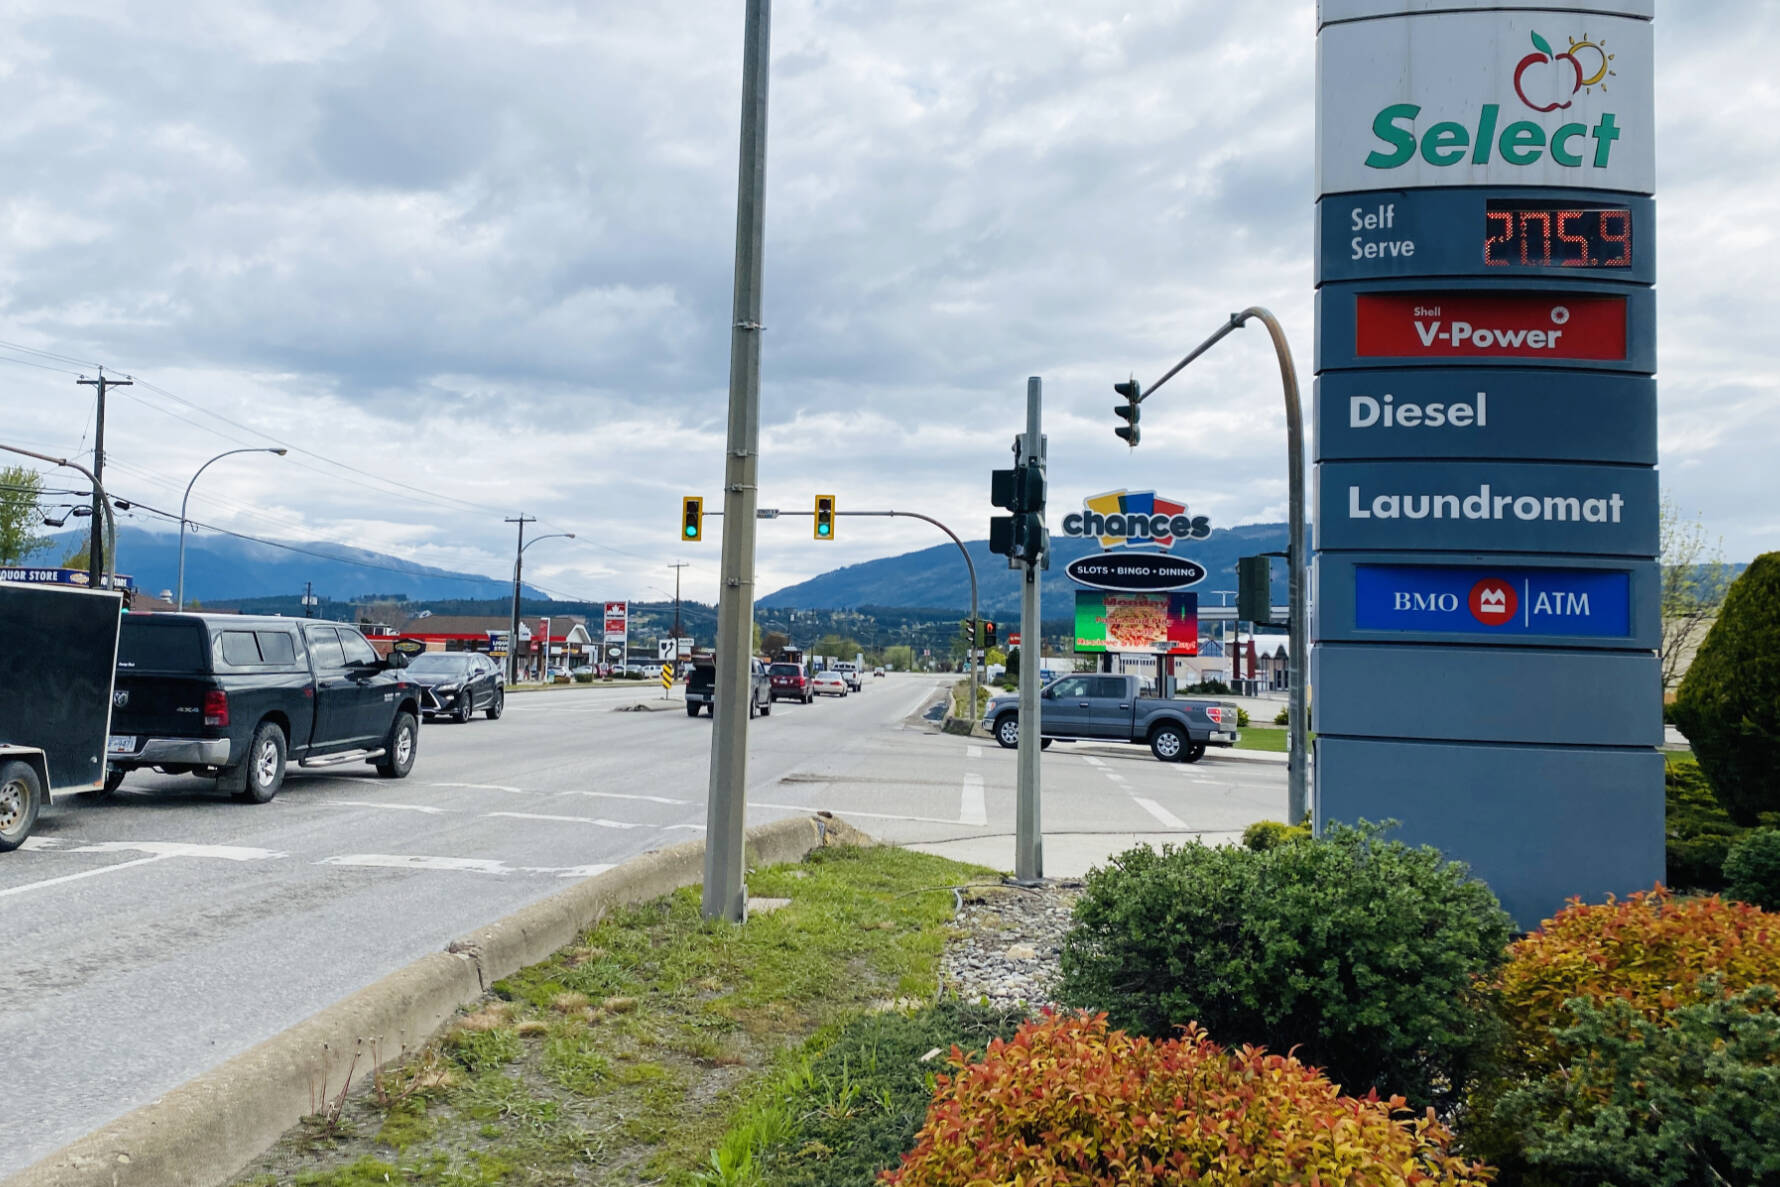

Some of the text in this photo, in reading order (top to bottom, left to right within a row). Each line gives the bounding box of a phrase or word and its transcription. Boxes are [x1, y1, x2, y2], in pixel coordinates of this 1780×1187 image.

[1364, 103, 1621, 169] Select
[1351, 204, 1395, 231] Self
[1351, 237, 1415, 260] Serve
[1414, 306, 1441, 317] Shell
[1414, 320, 1562, 348] V-Power
[1350, 392, 1487, 428] Diesel
[1349, 484, 1624, 523] Laundromat
[1062, 510, 1212, 540] chances
[29, 571, 58, 581] STORE
[1077, 566, 1196, 577] SLOTS BINGO DINING
[1394, 592, 1590, 616] BMO ATM
